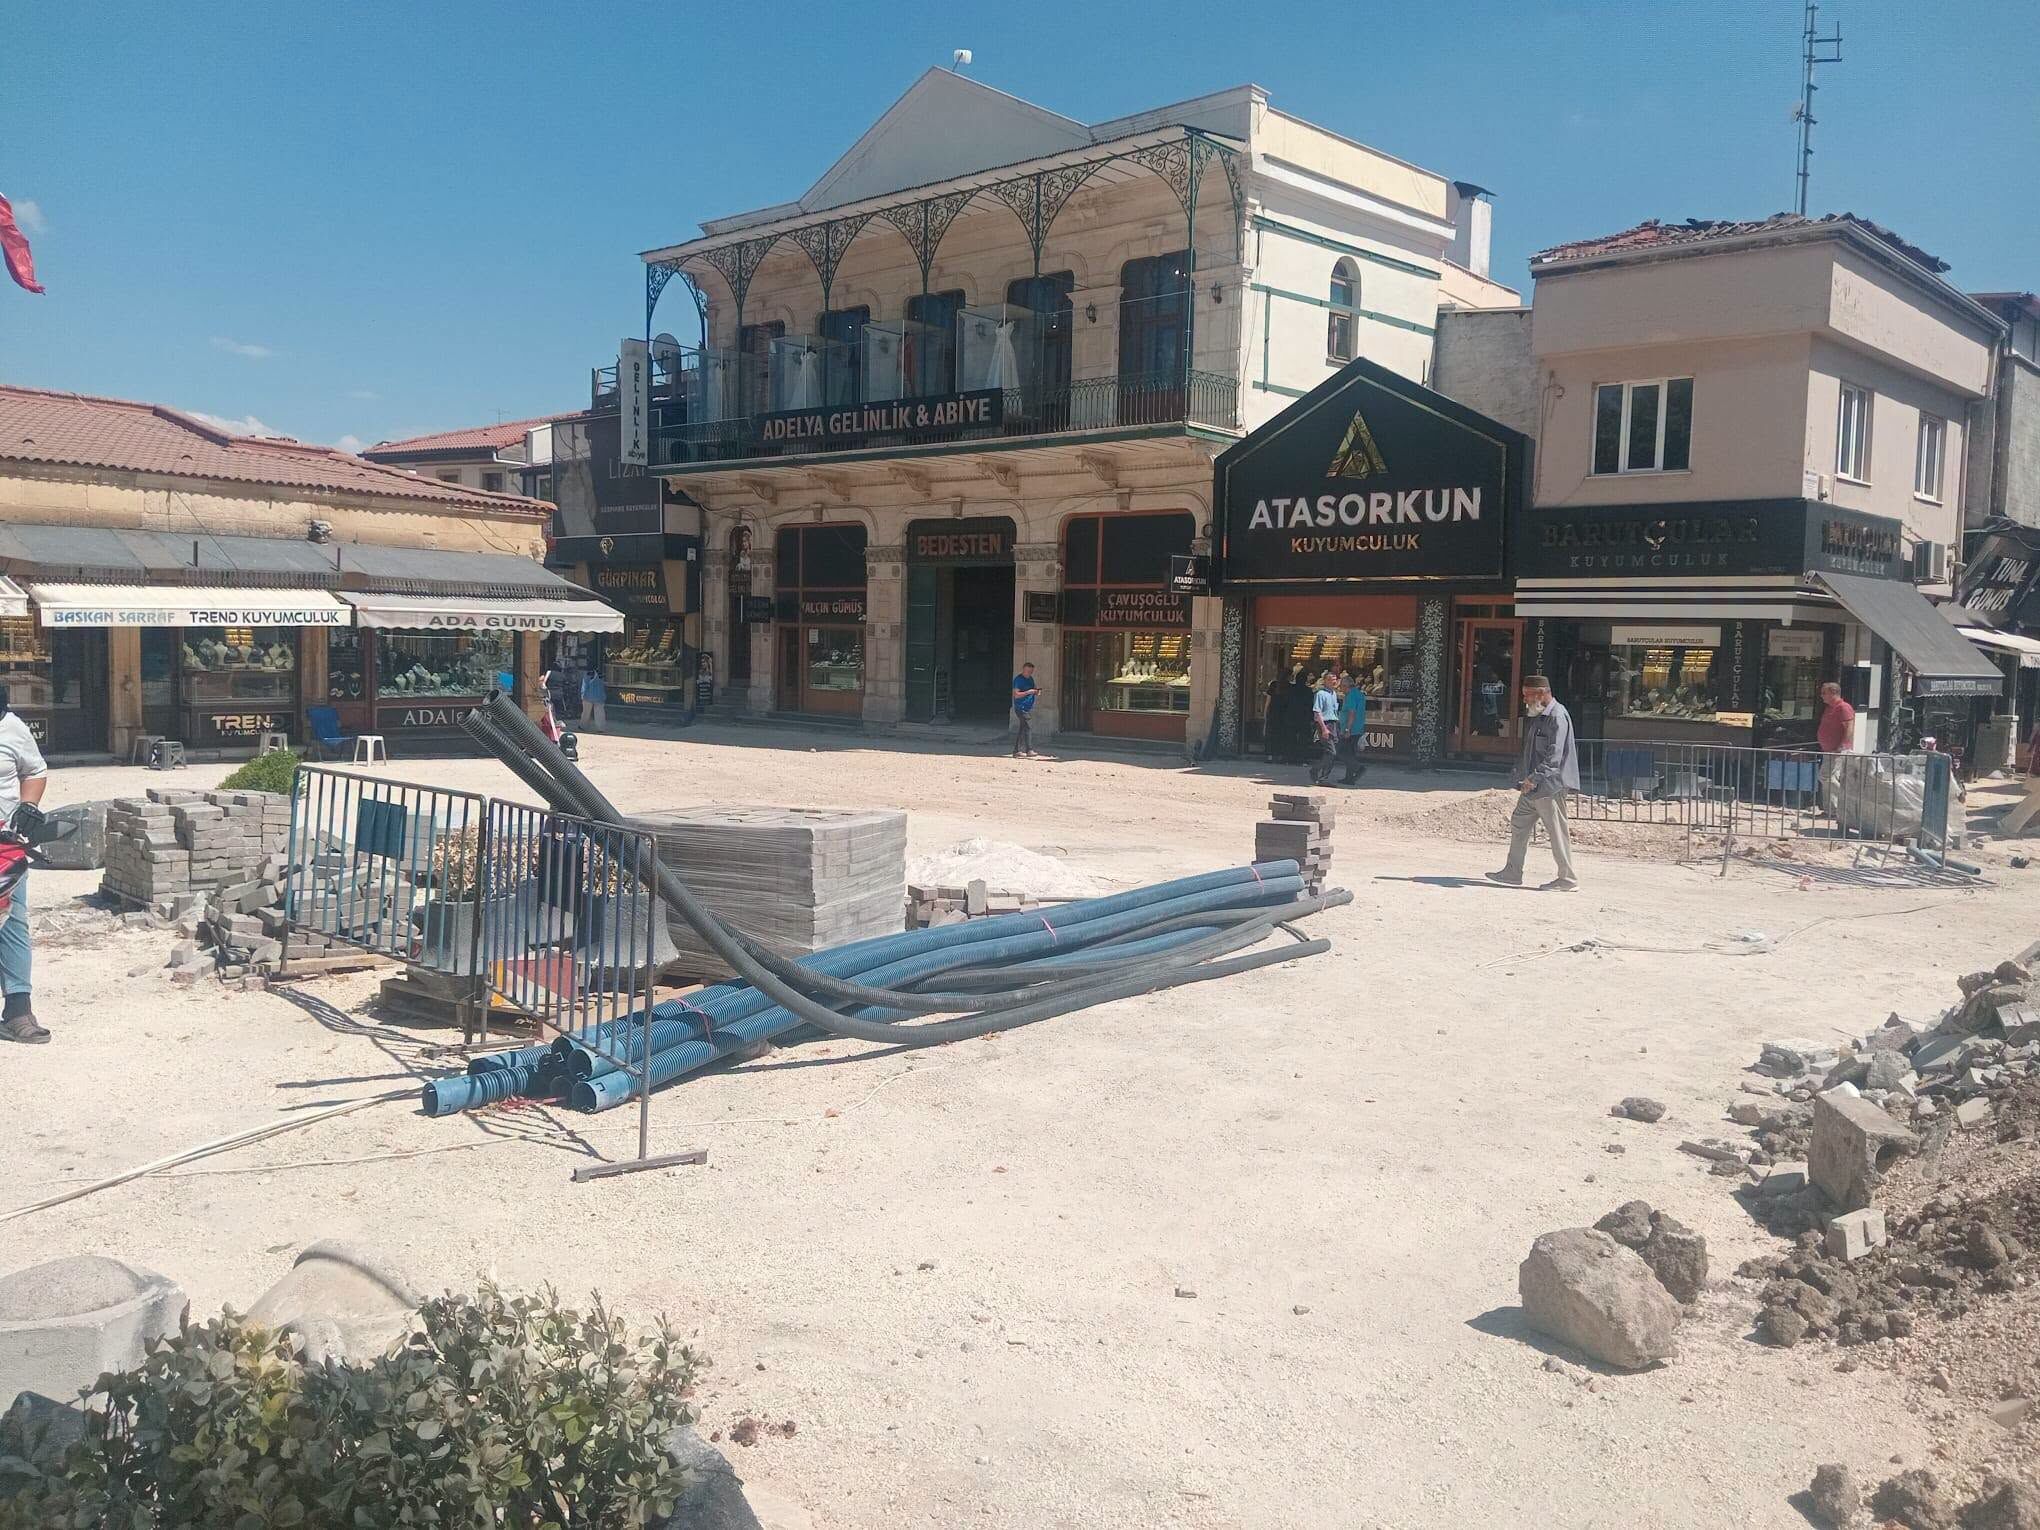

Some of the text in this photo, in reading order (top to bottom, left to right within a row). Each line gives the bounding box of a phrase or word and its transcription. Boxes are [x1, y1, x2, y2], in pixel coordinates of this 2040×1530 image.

[763, 394, 992, 440] ADELYA GELİNLİK & ABİYE
[1249, 487, 1481, 530] ATASORKUN
[917, 533, 1001, 556] BEDESTEN
[1291, 533, 1422, 553] KUYUMCULUK
[1570, 553, 1729, 568] KUYUMCULUK
[1108, 591, 1179, 609] ÇAVUŞOĞLU
[53, 611, 339, 624] BASKAN SARRAF TREND KUYUMCULUK
[429, 614, 566, 630] ADA GÜMÜŞ
[1101, 610, 1185, 622] KUYUMCULUK
[403, 709, 448, 725] ADA
